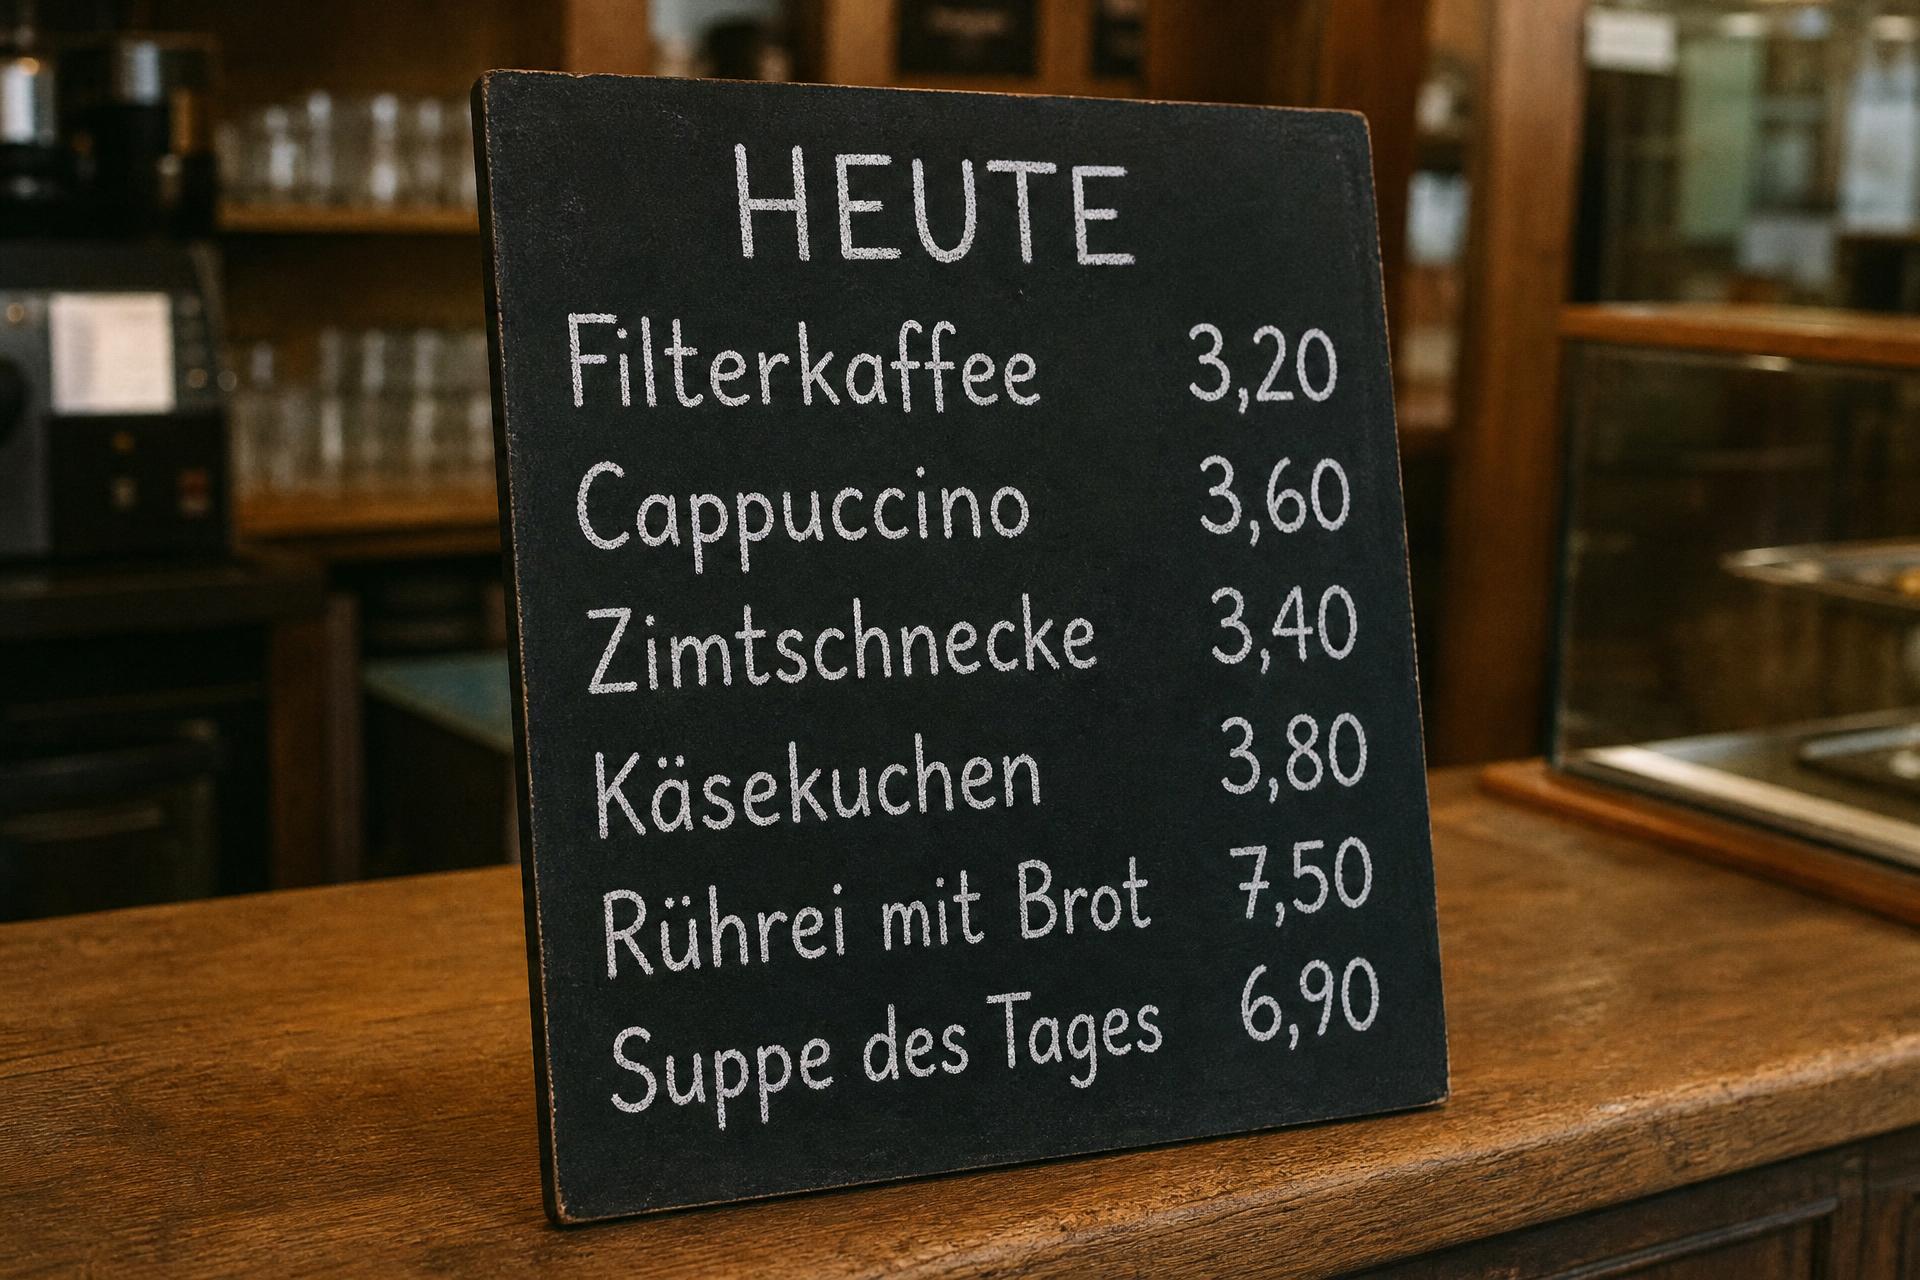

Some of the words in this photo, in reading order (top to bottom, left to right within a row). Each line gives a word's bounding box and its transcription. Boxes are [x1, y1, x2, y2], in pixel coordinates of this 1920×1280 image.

[734, 142, 1136, 266] HEUTE
[567, 311, 1041, 414] Filterkaffee
[1188, 322, 1338, 414] 3,20
[576, 460, 1030, 573] Cappuccino
[1199, 454, 1351, 546] 3,60
[586, 592, 1098, 695] Zimtschnecke
[1211, 584, 1358, 675] 3,40
[594, 732, 1041, 840] Käsekuchen
[1220, 712, 1368, 804] 3,80
[602, 884, 847, 981] Rührei
[881, 869, 985, 951] mit
[1017, 856, 1152, 940] Brot
[1229, 836, 1373, 928] 7,50
[610, 1025, 834, 1131] Suppe
[863, 1003, 971, 1083] des
[985, 991, 1163, 1091] Tages
[1240, 956, 1380, 1051] 6,90
